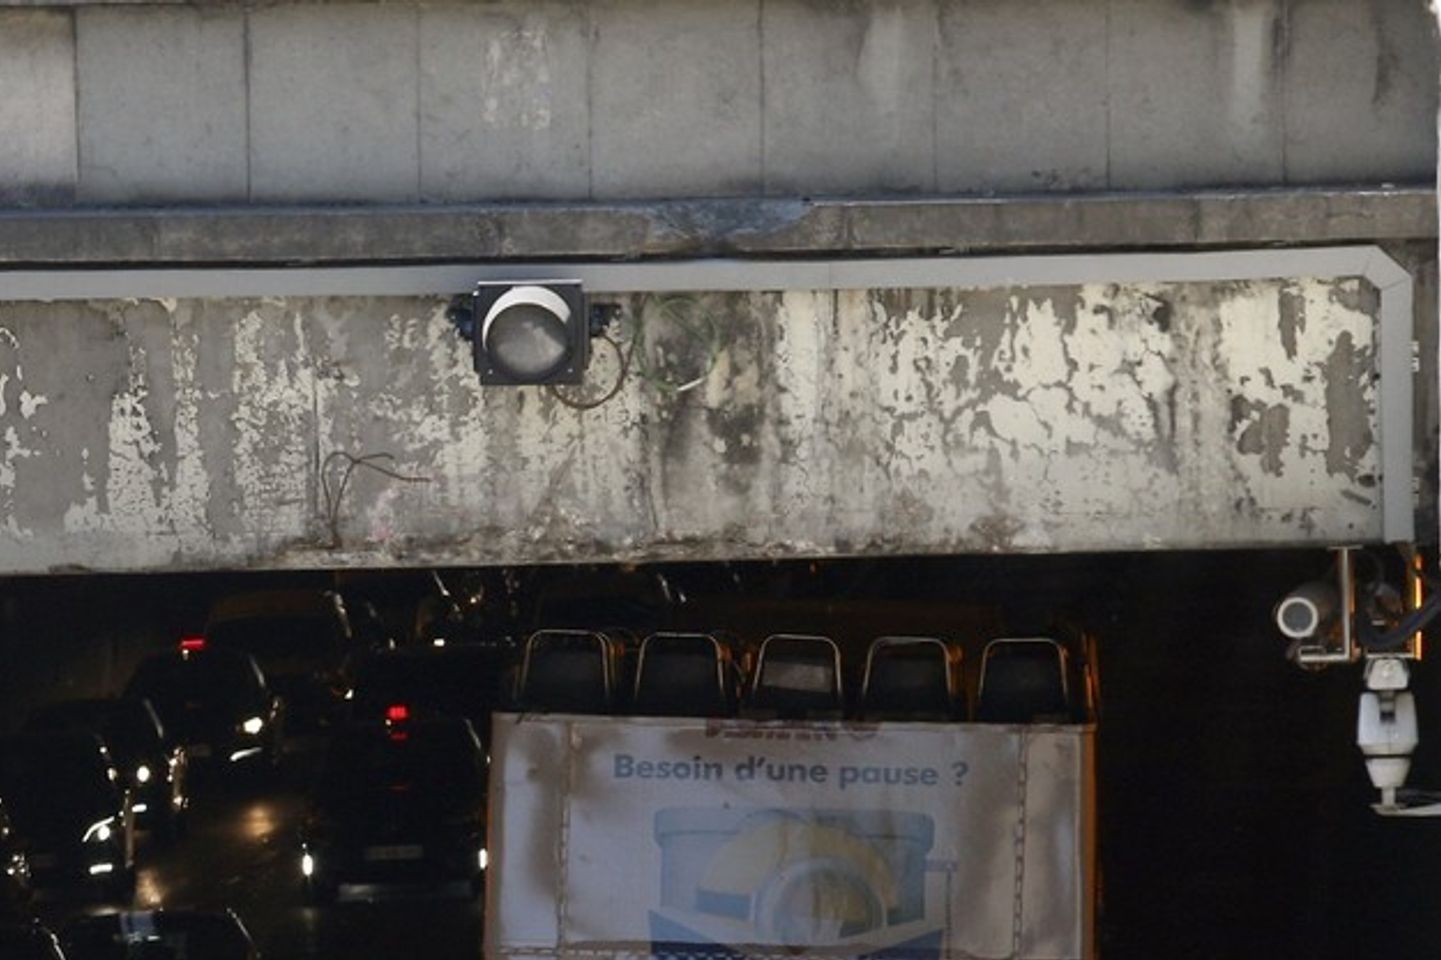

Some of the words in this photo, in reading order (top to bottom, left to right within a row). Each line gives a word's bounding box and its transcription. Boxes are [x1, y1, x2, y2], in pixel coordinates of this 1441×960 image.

[613, 754, 723, 781] Besoin
[735, 755, 828, 783] d'une
[838, 763, 939, 790] pause
[951, 761, 970, 786] ?
